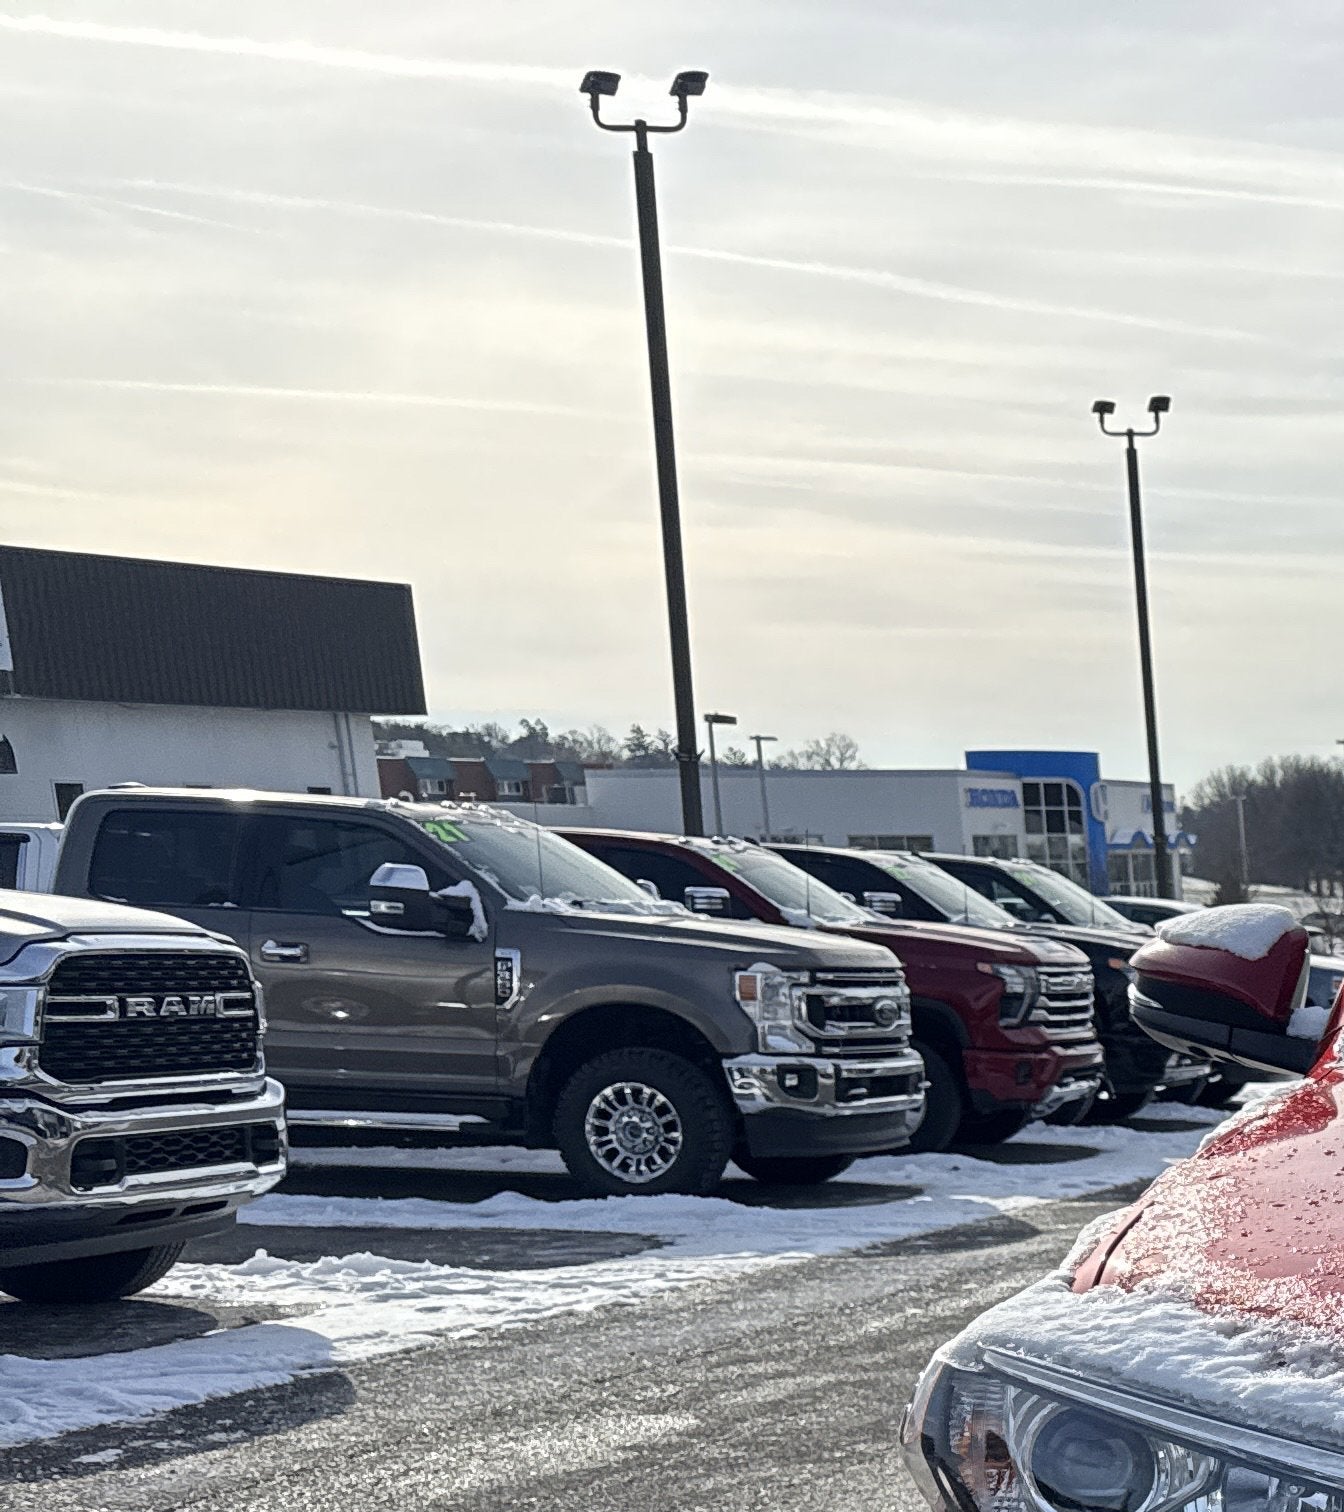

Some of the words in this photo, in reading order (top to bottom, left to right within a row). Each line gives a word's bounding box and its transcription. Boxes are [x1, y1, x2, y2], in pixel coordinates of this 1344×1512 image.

[966, 787, 1021, 809] HONDA
[423, 820, 471, 843] 21
[126, 996, 215, 1017] RAM
